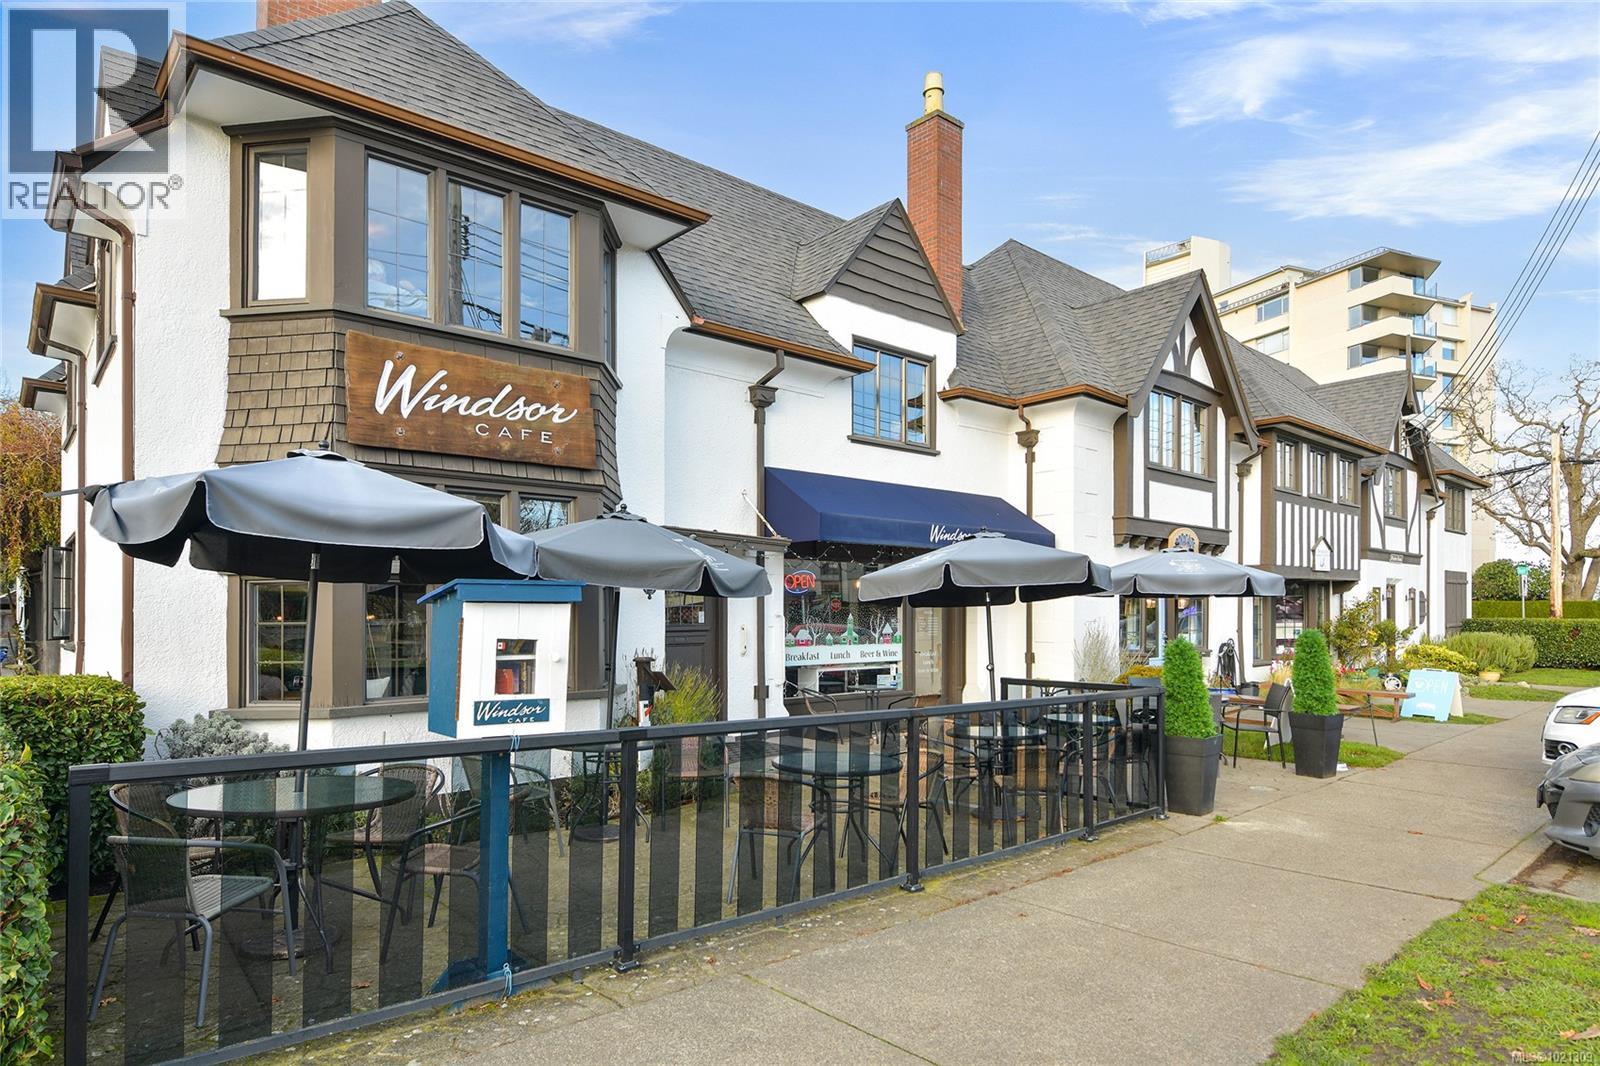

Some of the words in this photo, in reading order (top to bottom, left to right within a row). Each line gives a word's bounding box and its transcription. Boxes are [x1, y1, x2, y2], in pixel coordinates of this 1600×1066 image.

[375, 359, 578, 424] Windsor
[475, 423, 553, 444] CAFE
[929, 524, 971, 543] Windso
[784, 574, 816, 589] OPEN
[785, 653, 819, 662] Breakfast
[830, 650, 850, 660] Lunch
[860, 650, 874, 659] Beer
[882, 649, 899, 658] Wine
[476, 702, 546, 721] Windsor
